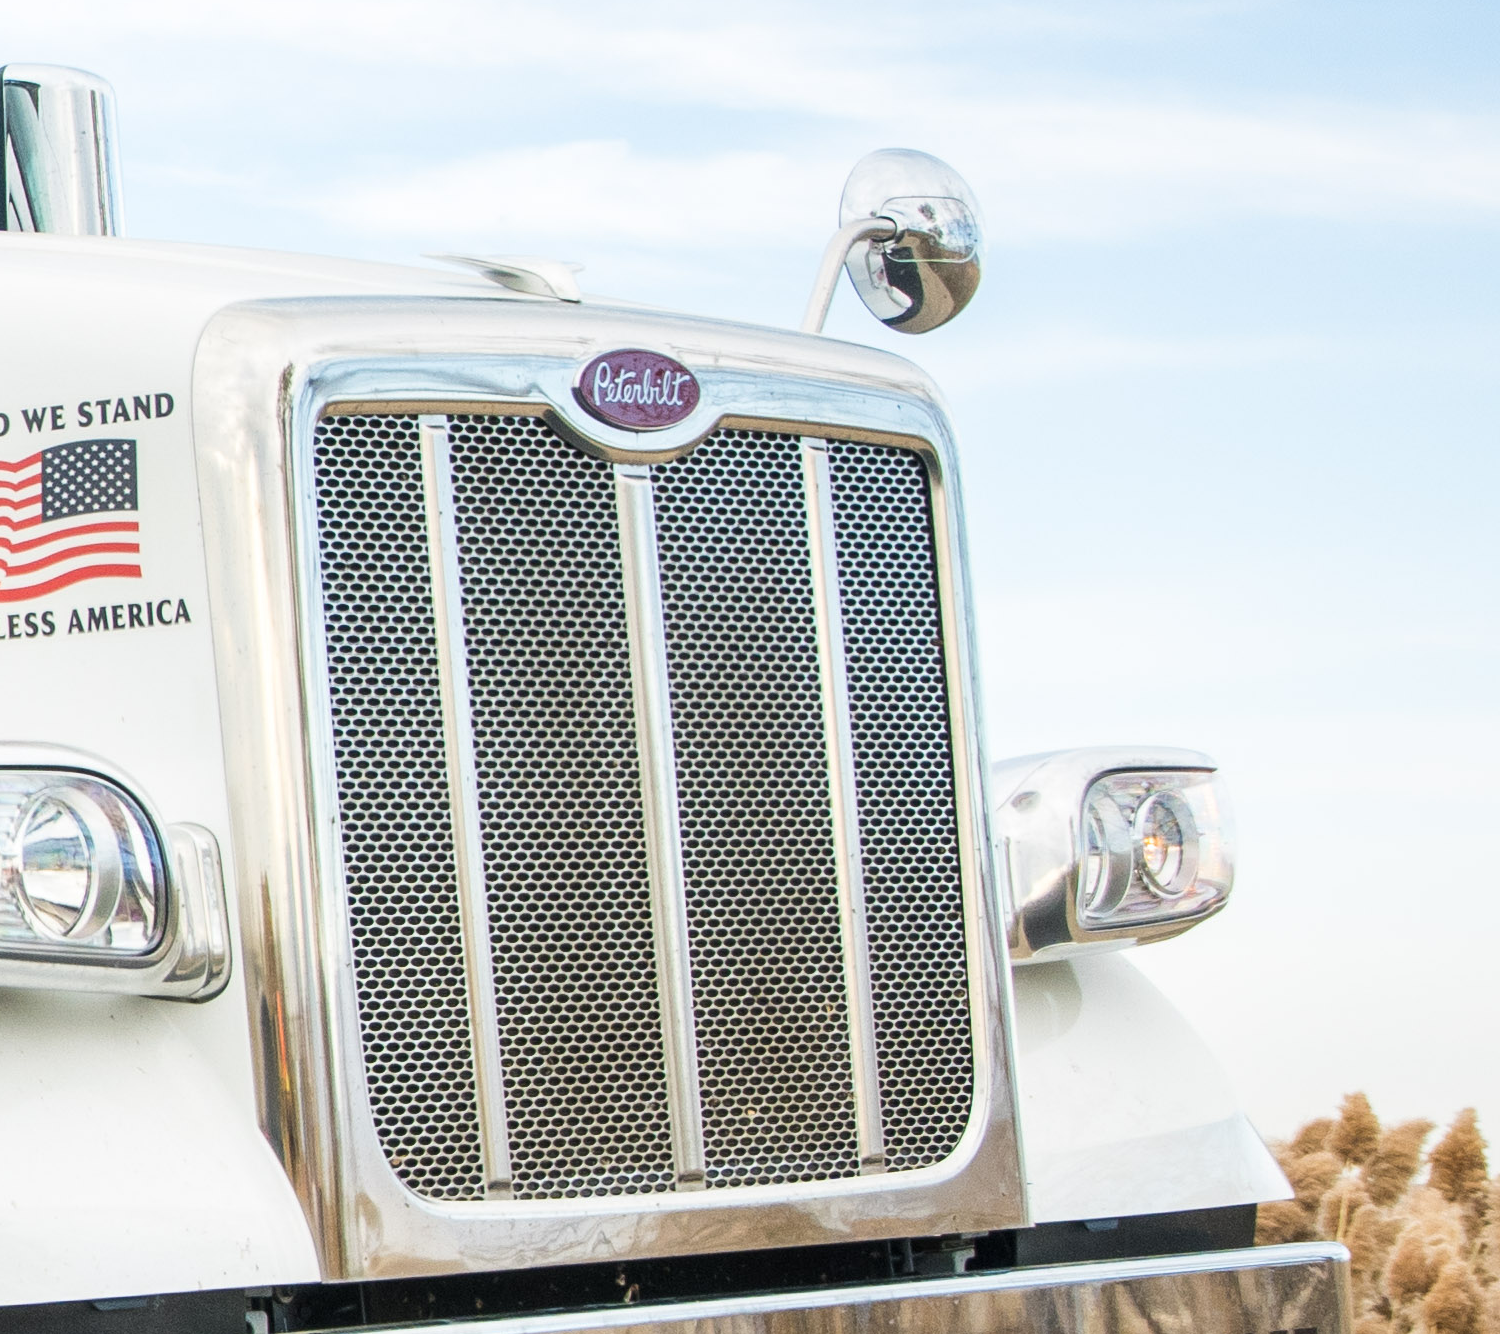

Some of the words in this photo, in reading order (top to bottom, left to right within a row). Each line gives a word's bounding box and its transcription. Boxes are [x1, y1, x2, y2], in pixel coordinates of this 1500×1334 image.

[593, 361, 691, 406] Peterbilt
[20, 405, 67, 434] WE
[76, 392, 175, 428] STAND
[67, 598, 192, 634] AMERICA
